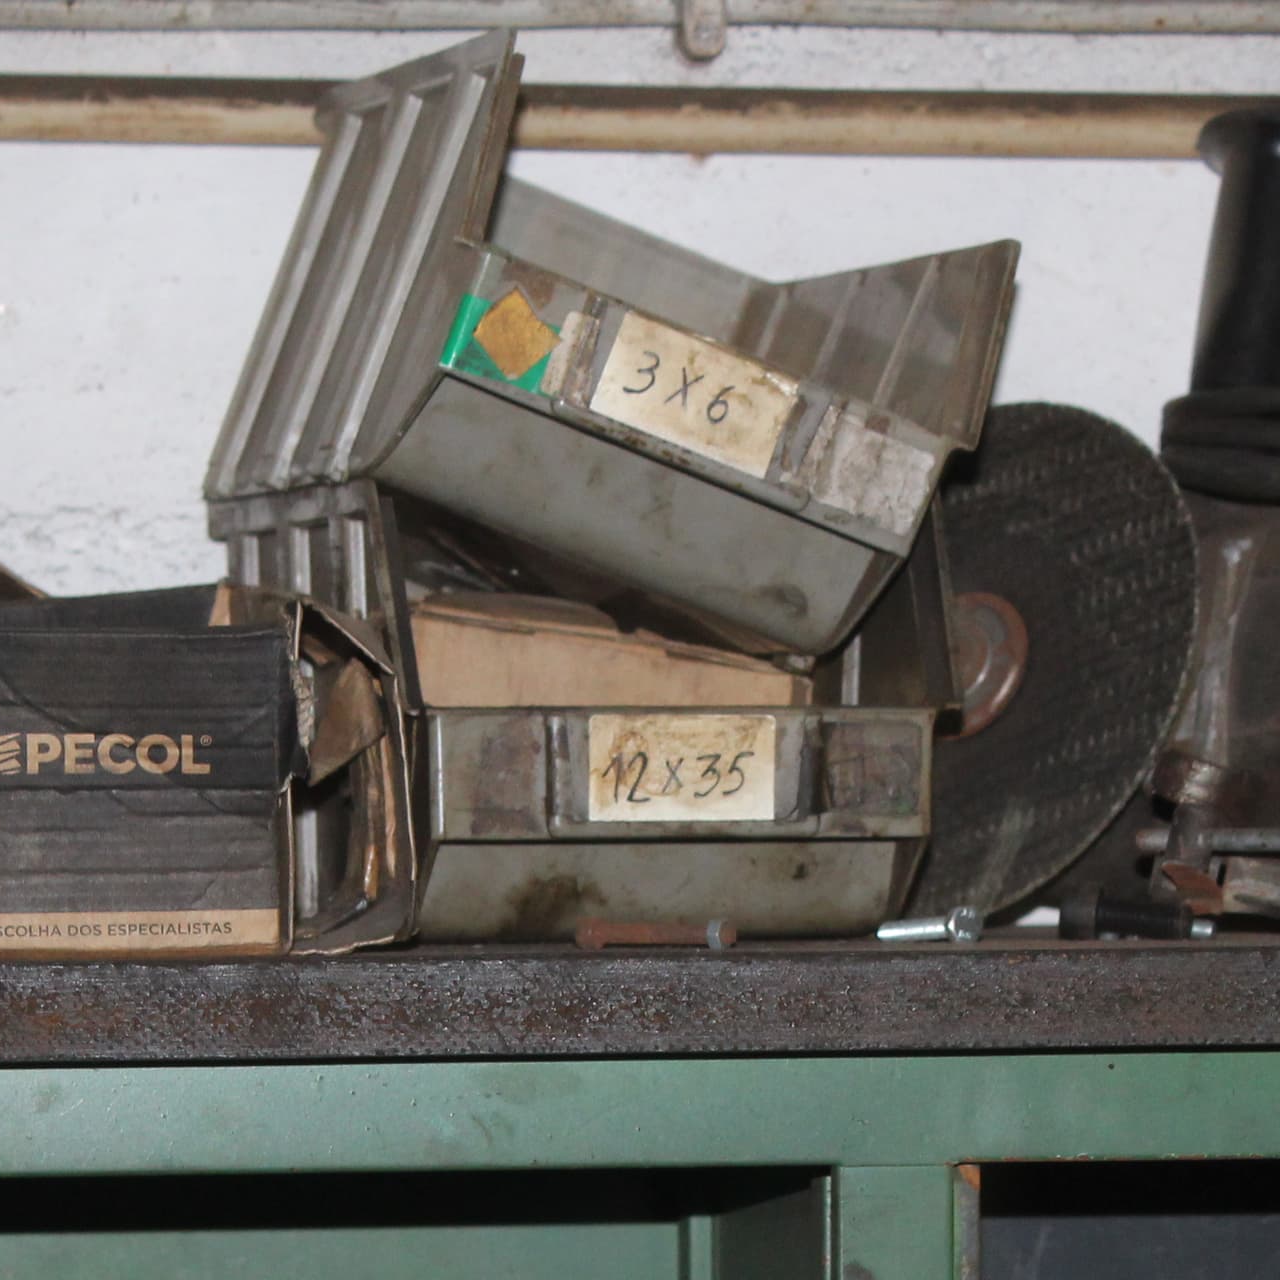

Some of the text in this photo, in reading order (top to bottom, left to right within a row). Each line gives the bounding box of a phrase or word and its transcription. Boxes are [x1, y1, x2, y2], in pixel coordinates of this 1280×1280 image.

[26, 732, 211, 775] PECOL
[67, 924, 102, 937] DOS
[107, 922, 233, 937] ESPECIALISTAS
